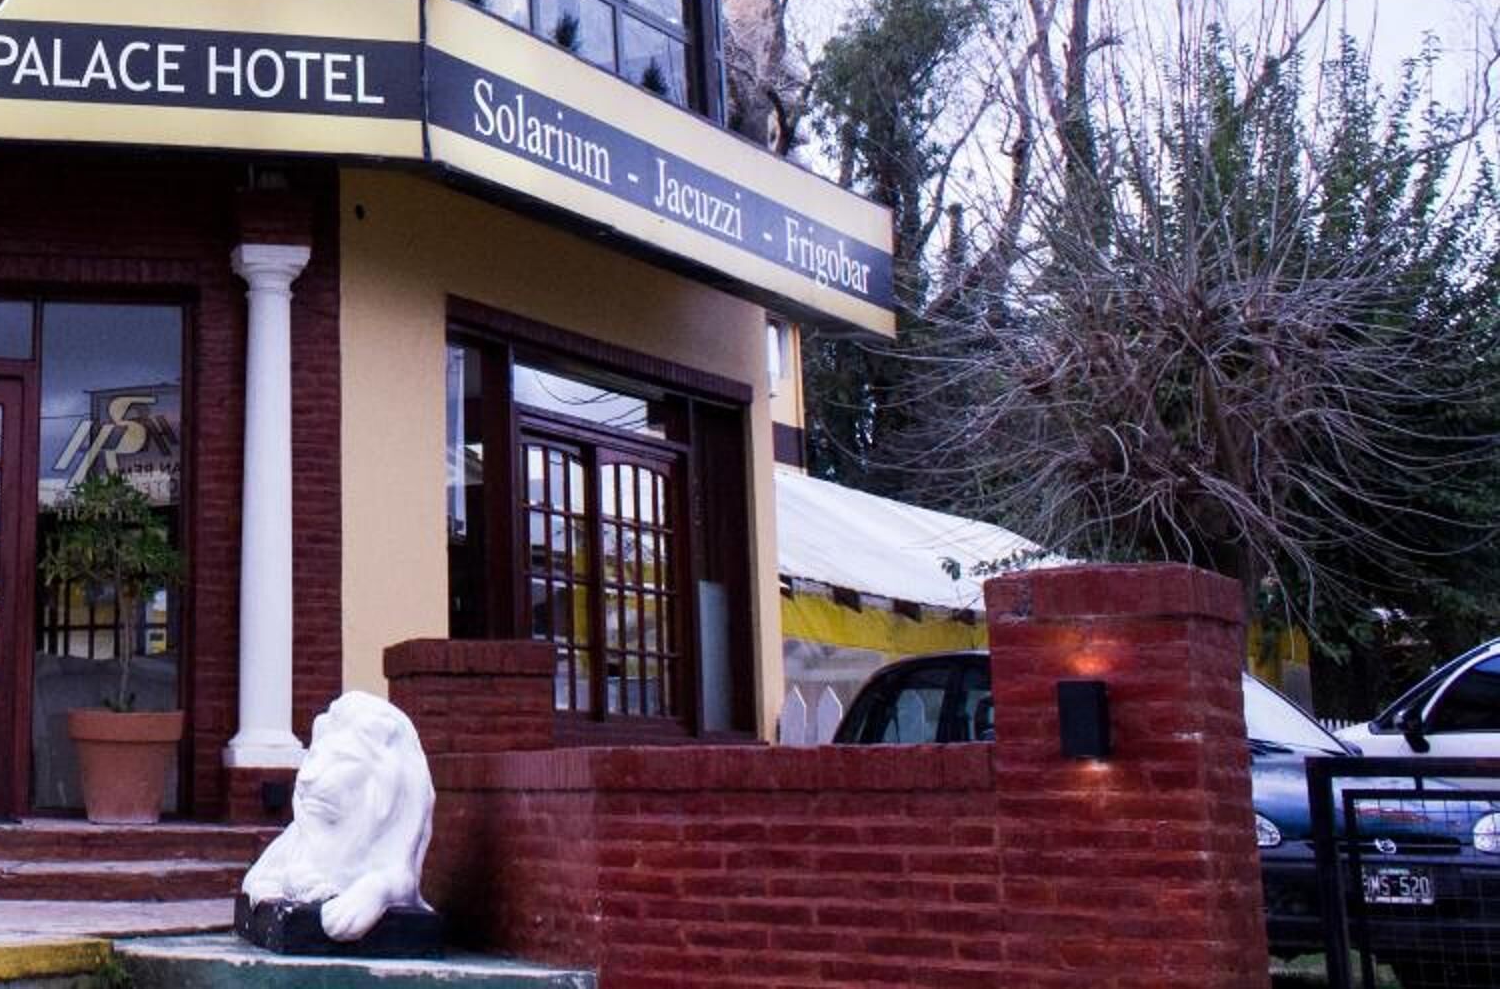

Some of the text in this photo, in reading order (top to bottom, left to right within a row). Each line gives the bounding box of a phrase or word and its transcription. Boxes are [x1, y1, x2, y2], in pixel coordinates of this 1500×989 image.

[207, 46, 385, 104] HOTEL
[472, 79, 612, 185] Solarium
[653, 159, 743, 241] Jacuzzi
[784, 216, 871, 294] Frigobar
[1399, 875, 1431, 897] 520
